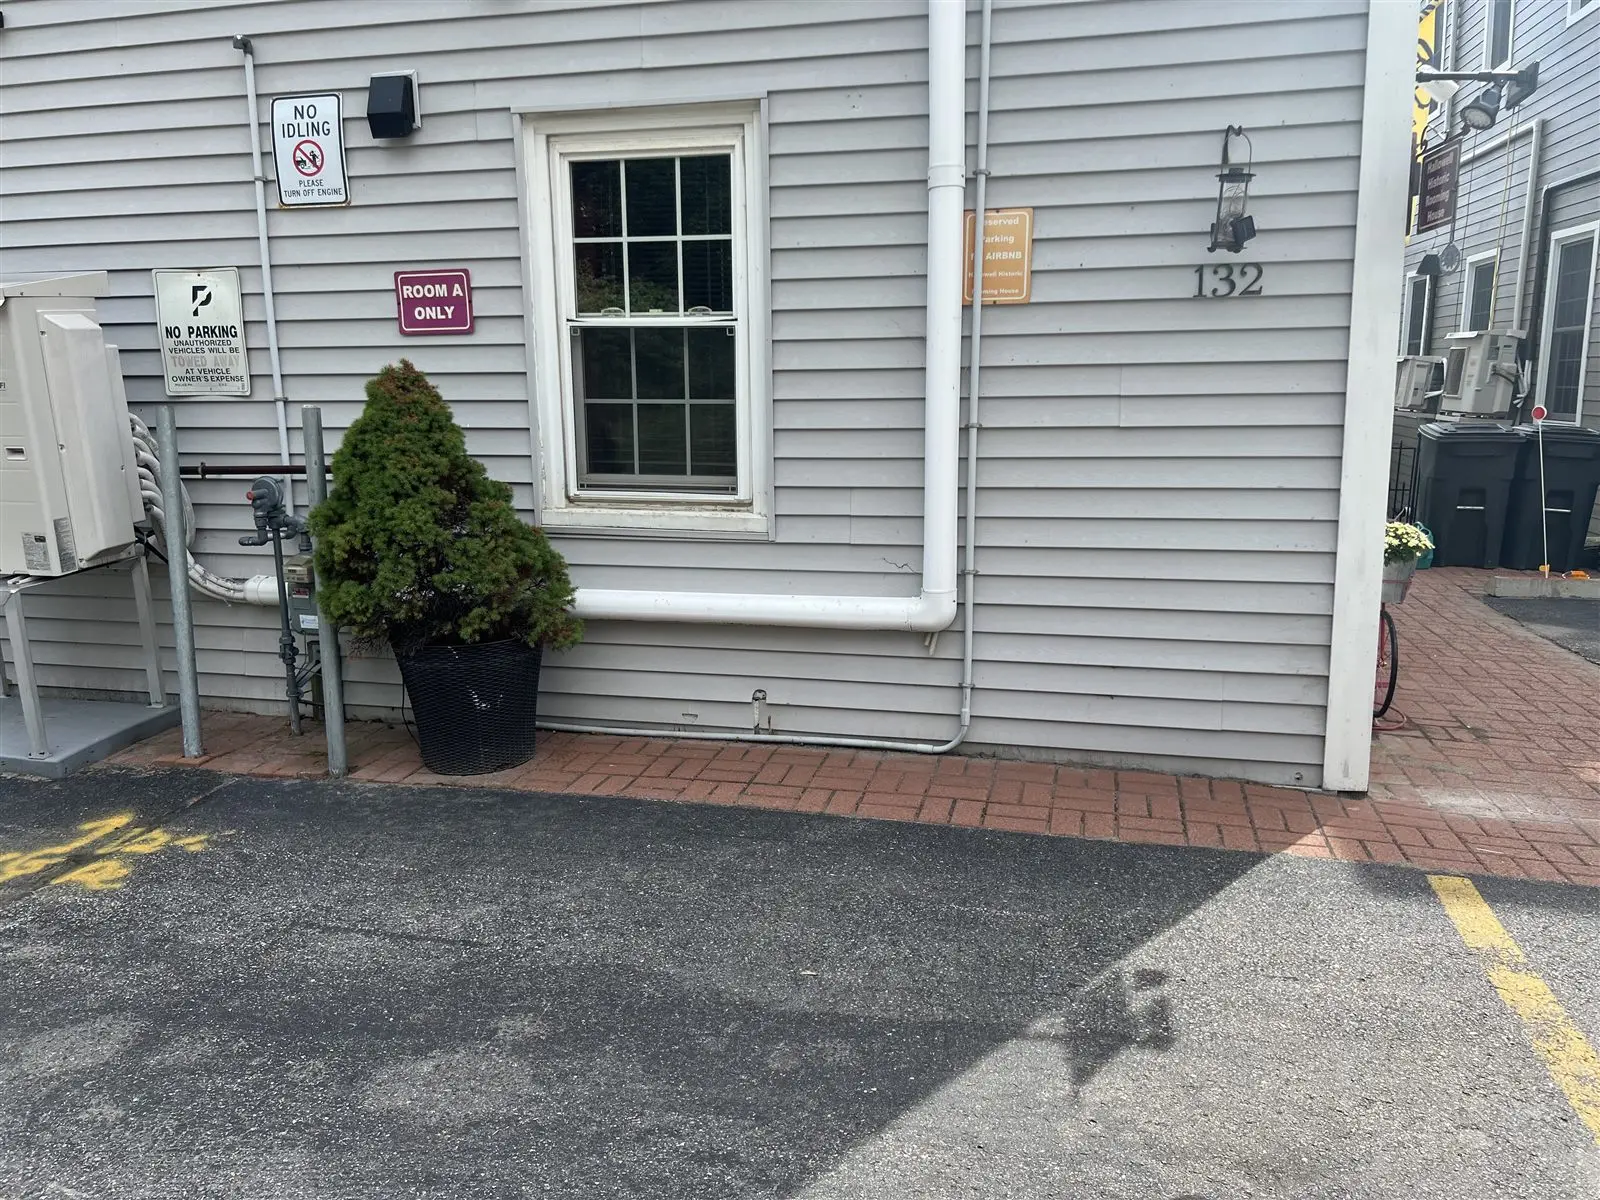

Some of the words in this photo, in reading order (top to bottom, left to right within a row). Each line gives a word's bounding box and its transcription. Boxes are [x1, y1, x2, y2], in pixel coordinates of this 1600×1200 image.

[294, 104, 317, 120] NO
[281, 121, 331, 138] IDLING
[298, 179, 324, 187] PLEASE
[284, 189, 301, 198] TURN
[303, 189, 315, 197] OFF
[318, 188, 343, 196] ENGINE
[983, 216, 1019, 226] served
[983, 234, 1015, 244] arking
[985, 251, 1023, 260] AIRBNB
[1193, 262, 1263, 298] 132
[402, 284, 448, 299] ROOM
[452, 283, 464, 297] A
[414, 306, 455, 320] ONLY
[165, 326, 181, 339] NO
[187, 325, 238, 339] PARKING
[173, 339, 232, 347] UNAUTHORIZED
[229, 346, 240, 354] BE
[171, 355, 207, 367] TOWED
[213, 355, 240, 367] AWAY
